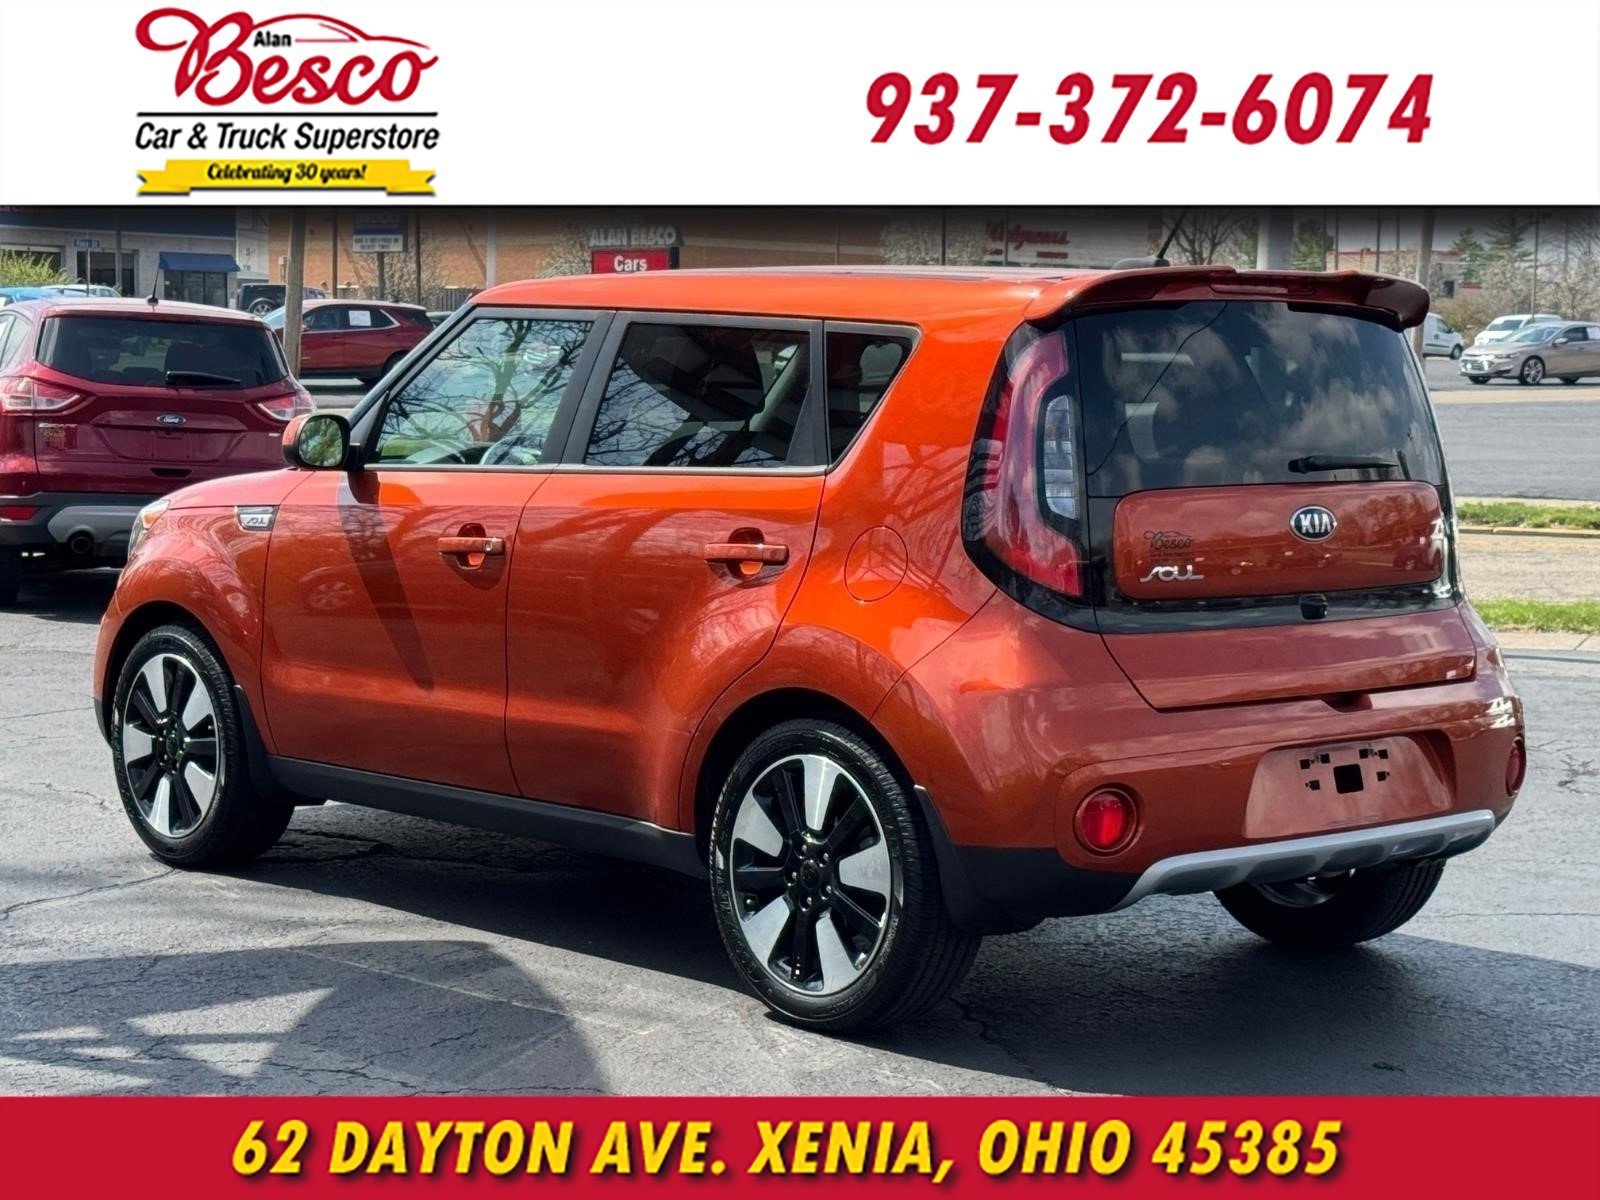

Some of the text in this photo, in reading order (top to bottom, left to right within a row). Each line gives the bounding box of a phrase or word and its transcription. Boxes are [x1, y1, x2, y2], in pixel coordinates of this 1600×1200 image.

[589, 226, 677, 246] ALAN BESCO
[614, 255, 648, 272] Cars
[1299, 513, 1331, 533] KIA
[1139, 564, 1205, 583] SOUL
